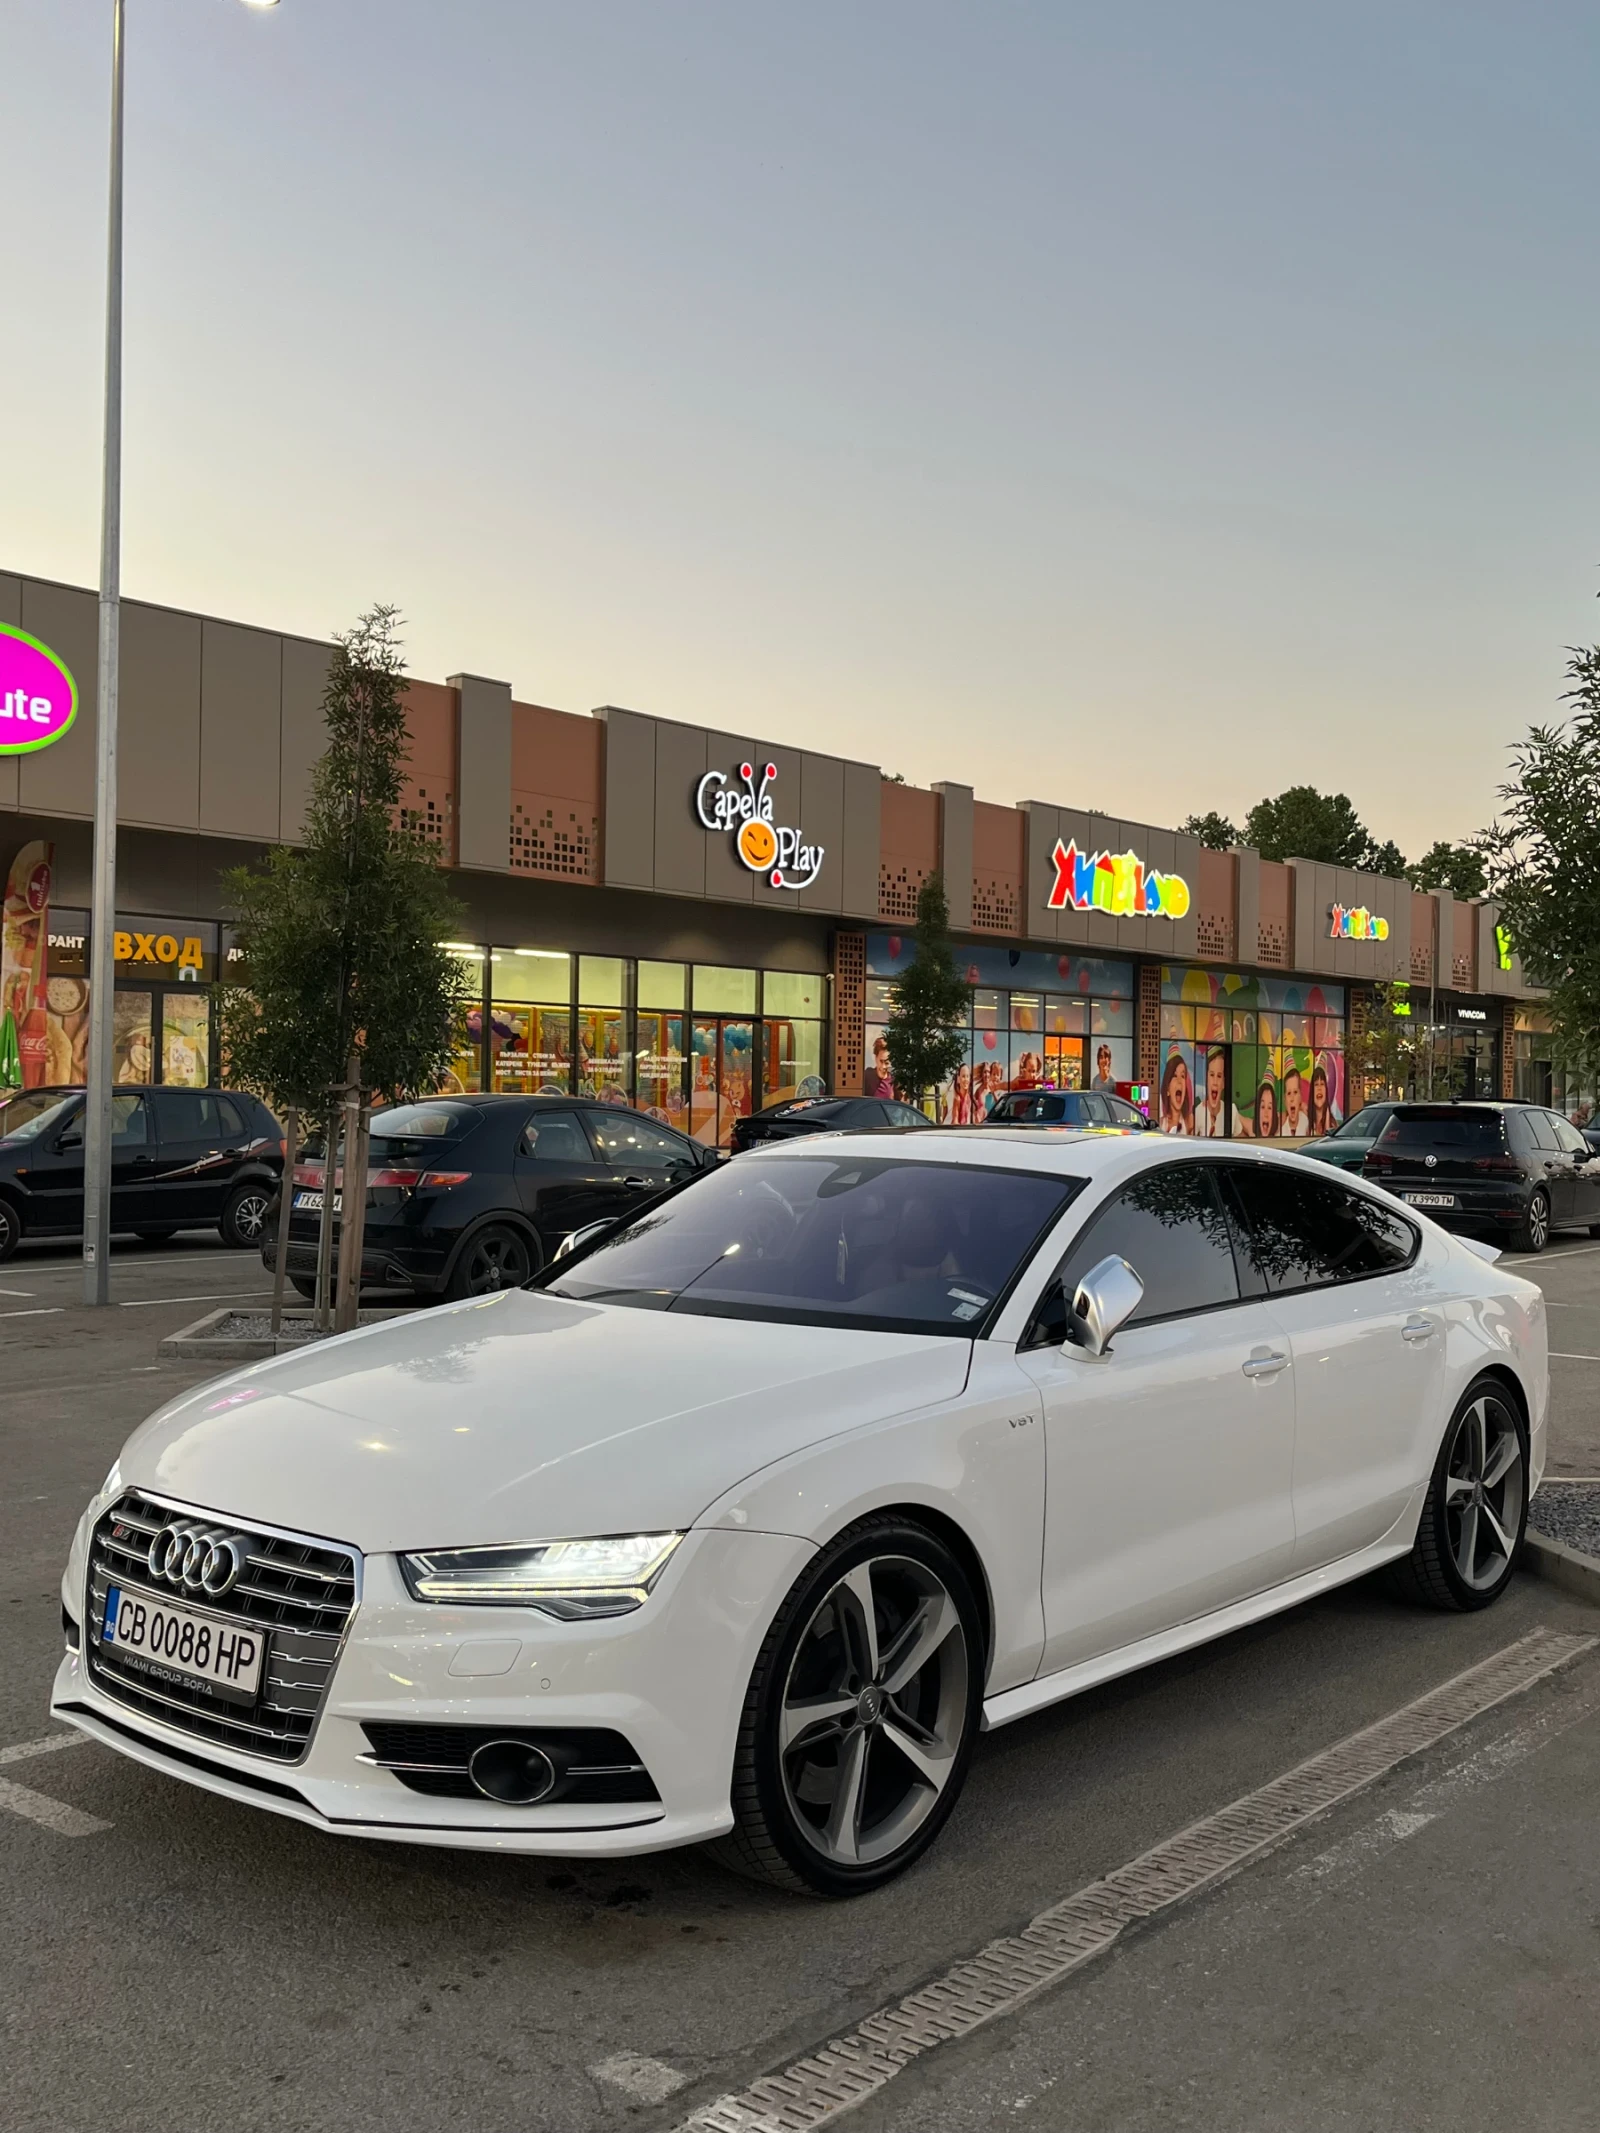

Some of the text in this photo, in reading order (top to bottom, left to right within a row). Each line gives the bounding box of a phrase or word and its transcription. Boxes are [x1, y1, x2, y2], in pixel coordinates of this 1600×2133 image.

[697, 762, 778, 831] Capella
[776, 827, 825, 889] Play
[113, 931, 203, 969] ВХОД
[1457, 1008, 1487, 1020] VIVACOM
[1407, 1194, 1453, 1205] TX 3990 TM
[105, 1620, 115, 1634] BG
[118, 1599, 256, 1680] CB 0088 HP
[123, 1655, 213, 1695] MIAMI GROUP SOFIA
